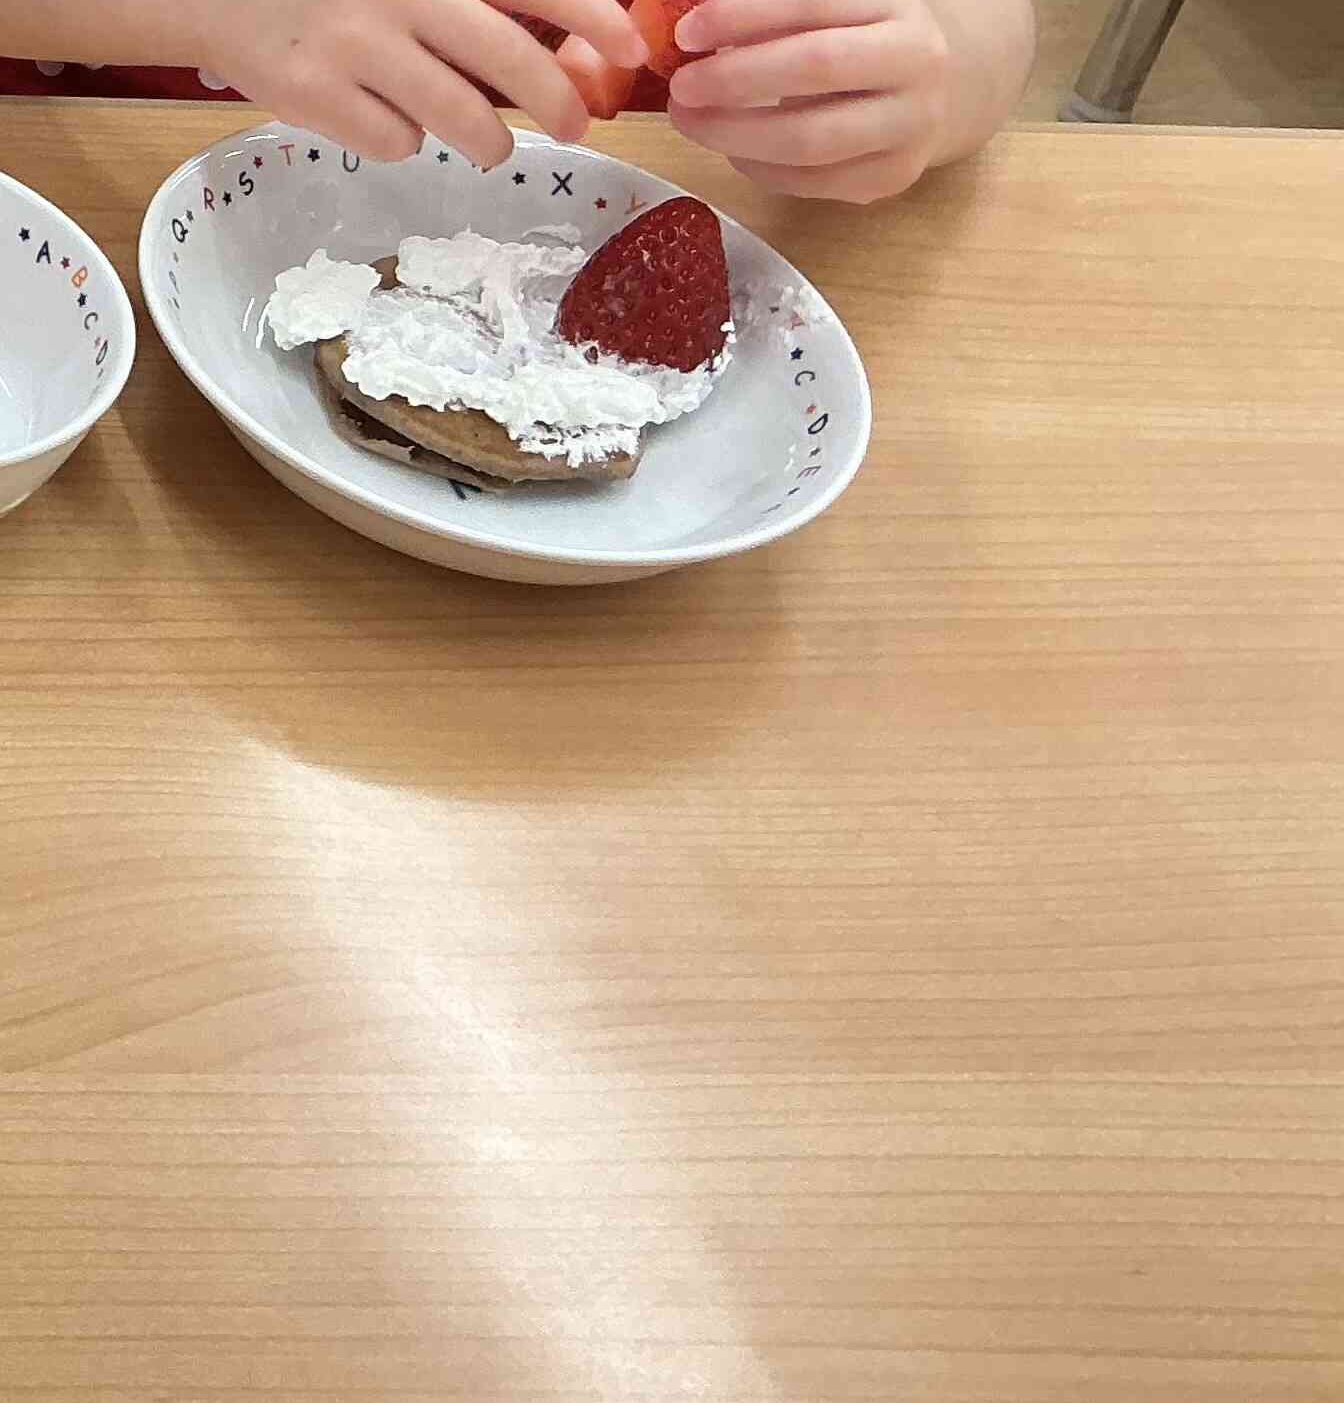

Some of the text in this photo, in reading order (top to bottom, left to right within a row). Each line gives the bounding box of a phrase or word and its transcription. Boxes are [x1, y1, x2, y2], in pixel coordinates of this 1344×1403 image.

[35, 239, 52, 264] A
[71, 265, 89, 288] B
[83, 311, 99, 331] C
[171, 218, 189, 243] Q
[202, 186, 216, 212] R
[238, 170, 255, 196] S
[278, 143, 295, 166] T
[343, 149, 360, 173] U
[551, 171, 573, 197] X
[794, 370, 816, 387] C
[807, 413, 829, 435] D
